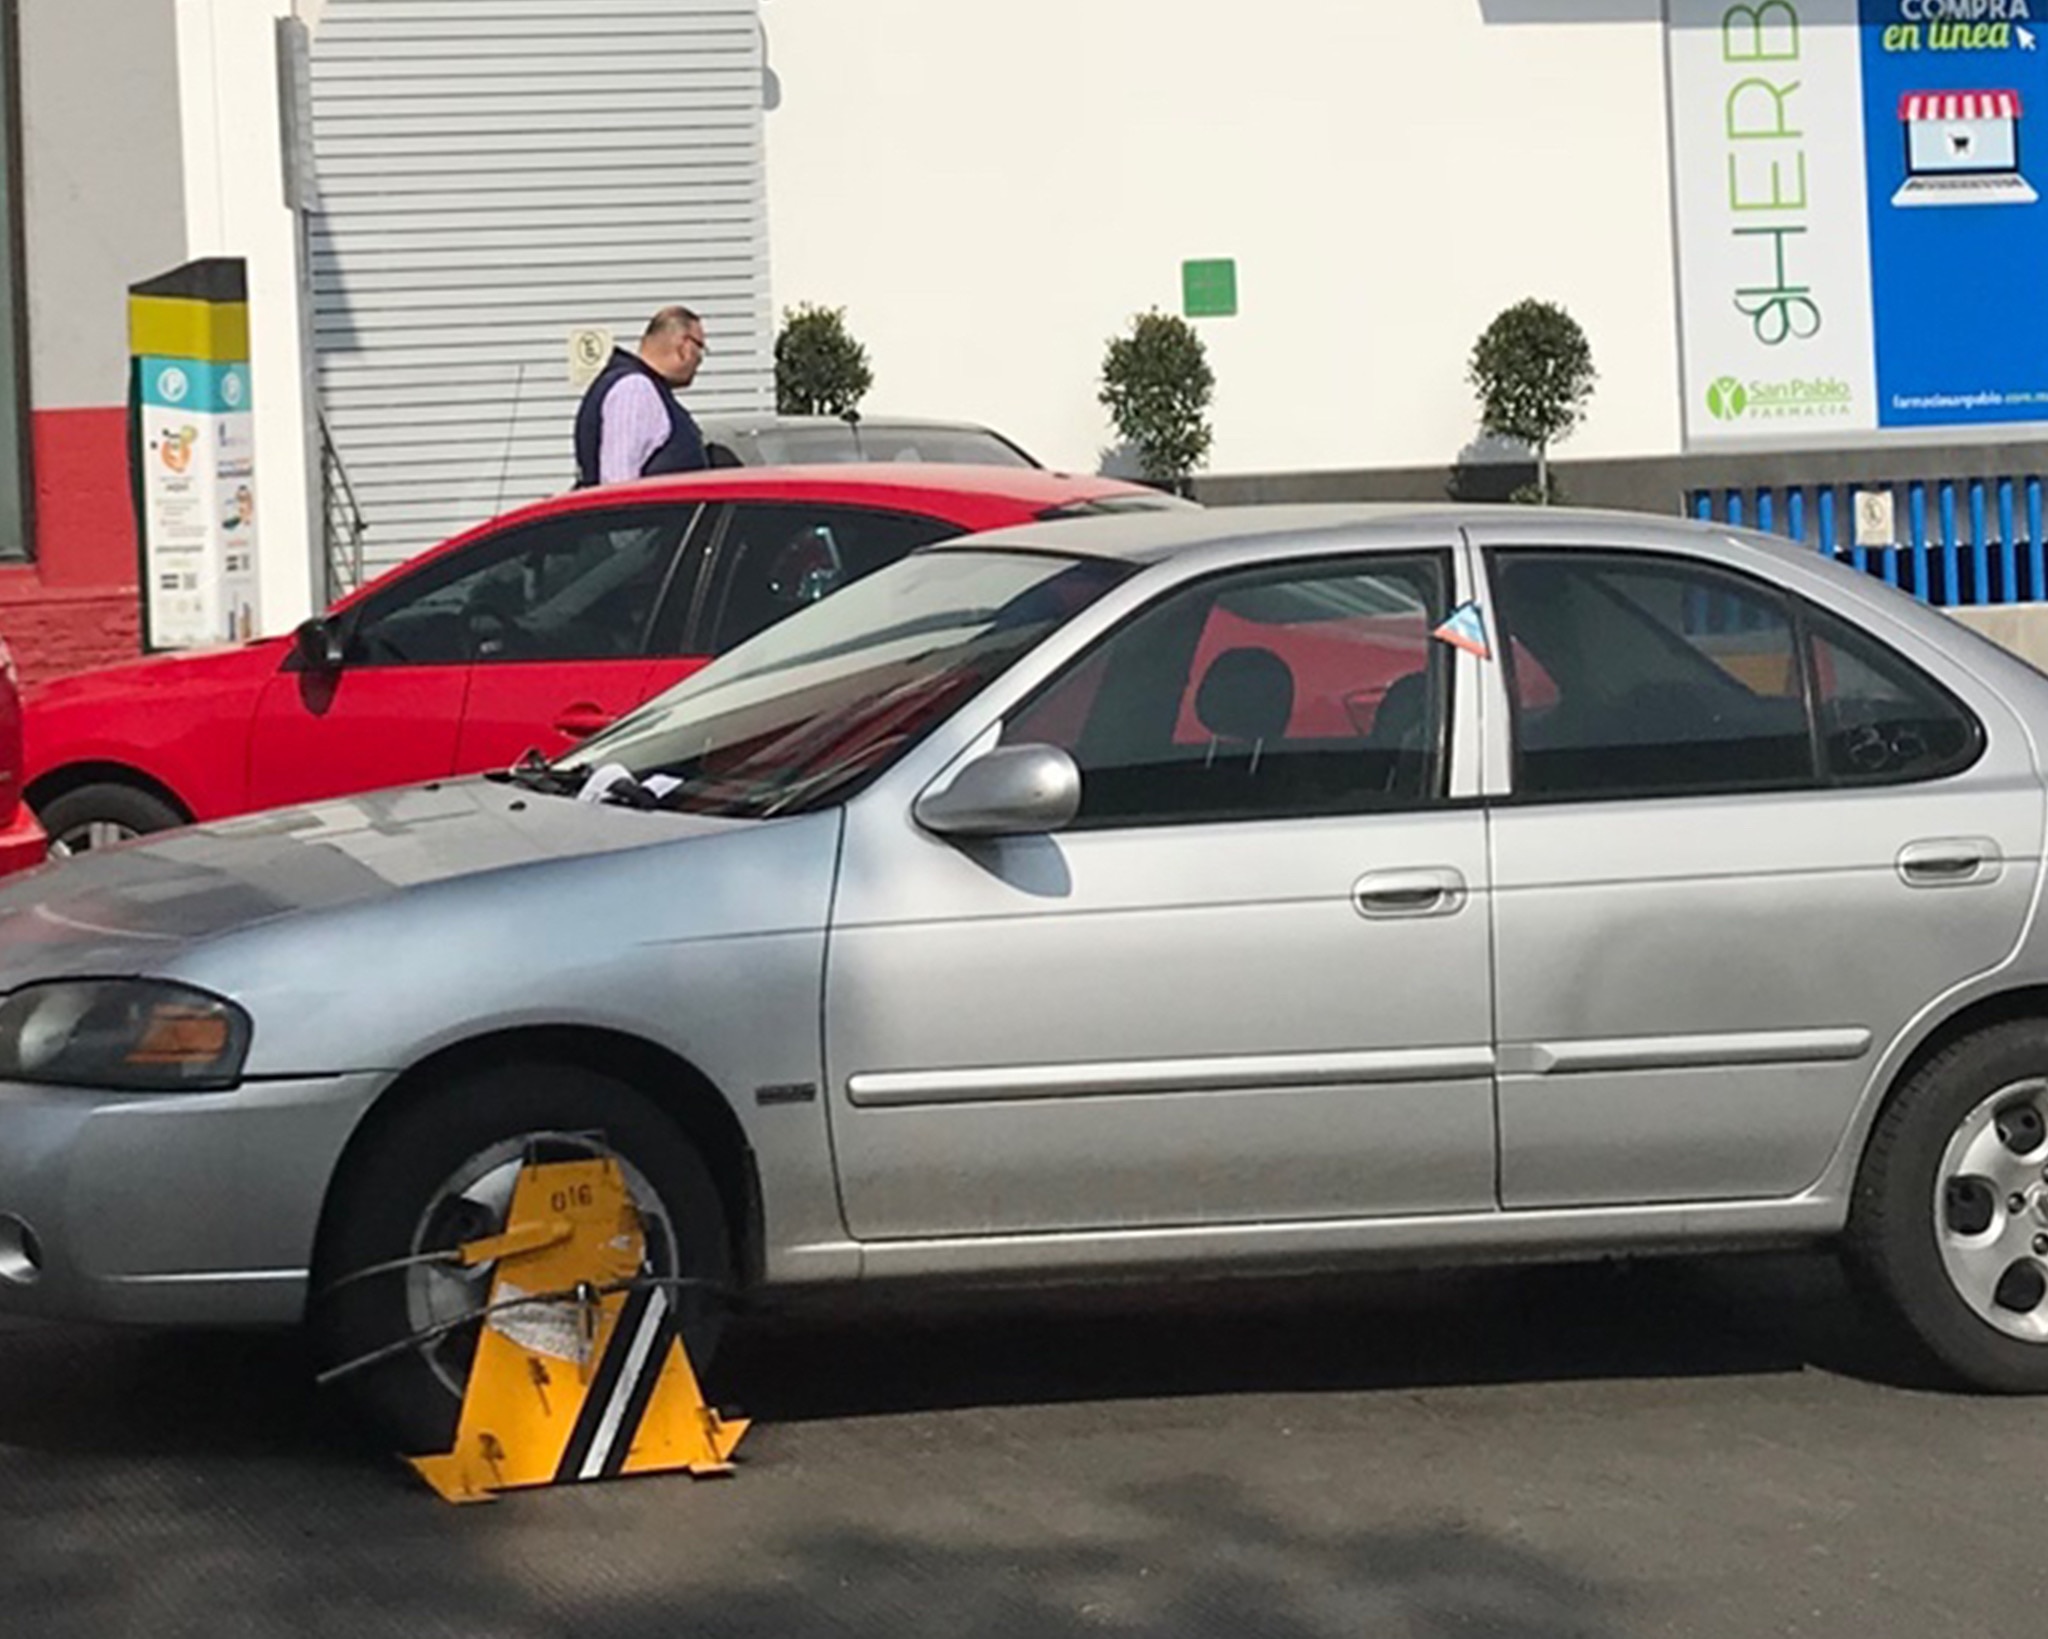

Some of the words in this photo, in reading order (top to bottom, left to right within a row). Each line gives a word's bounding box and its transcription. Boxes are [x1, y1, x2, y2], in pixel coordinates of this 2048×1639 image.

[1901, 0, 2030, 20] COMPRA
[1883, 23, 1921, 51] en
[1751, 404, 1850, 418] FARMACIA
